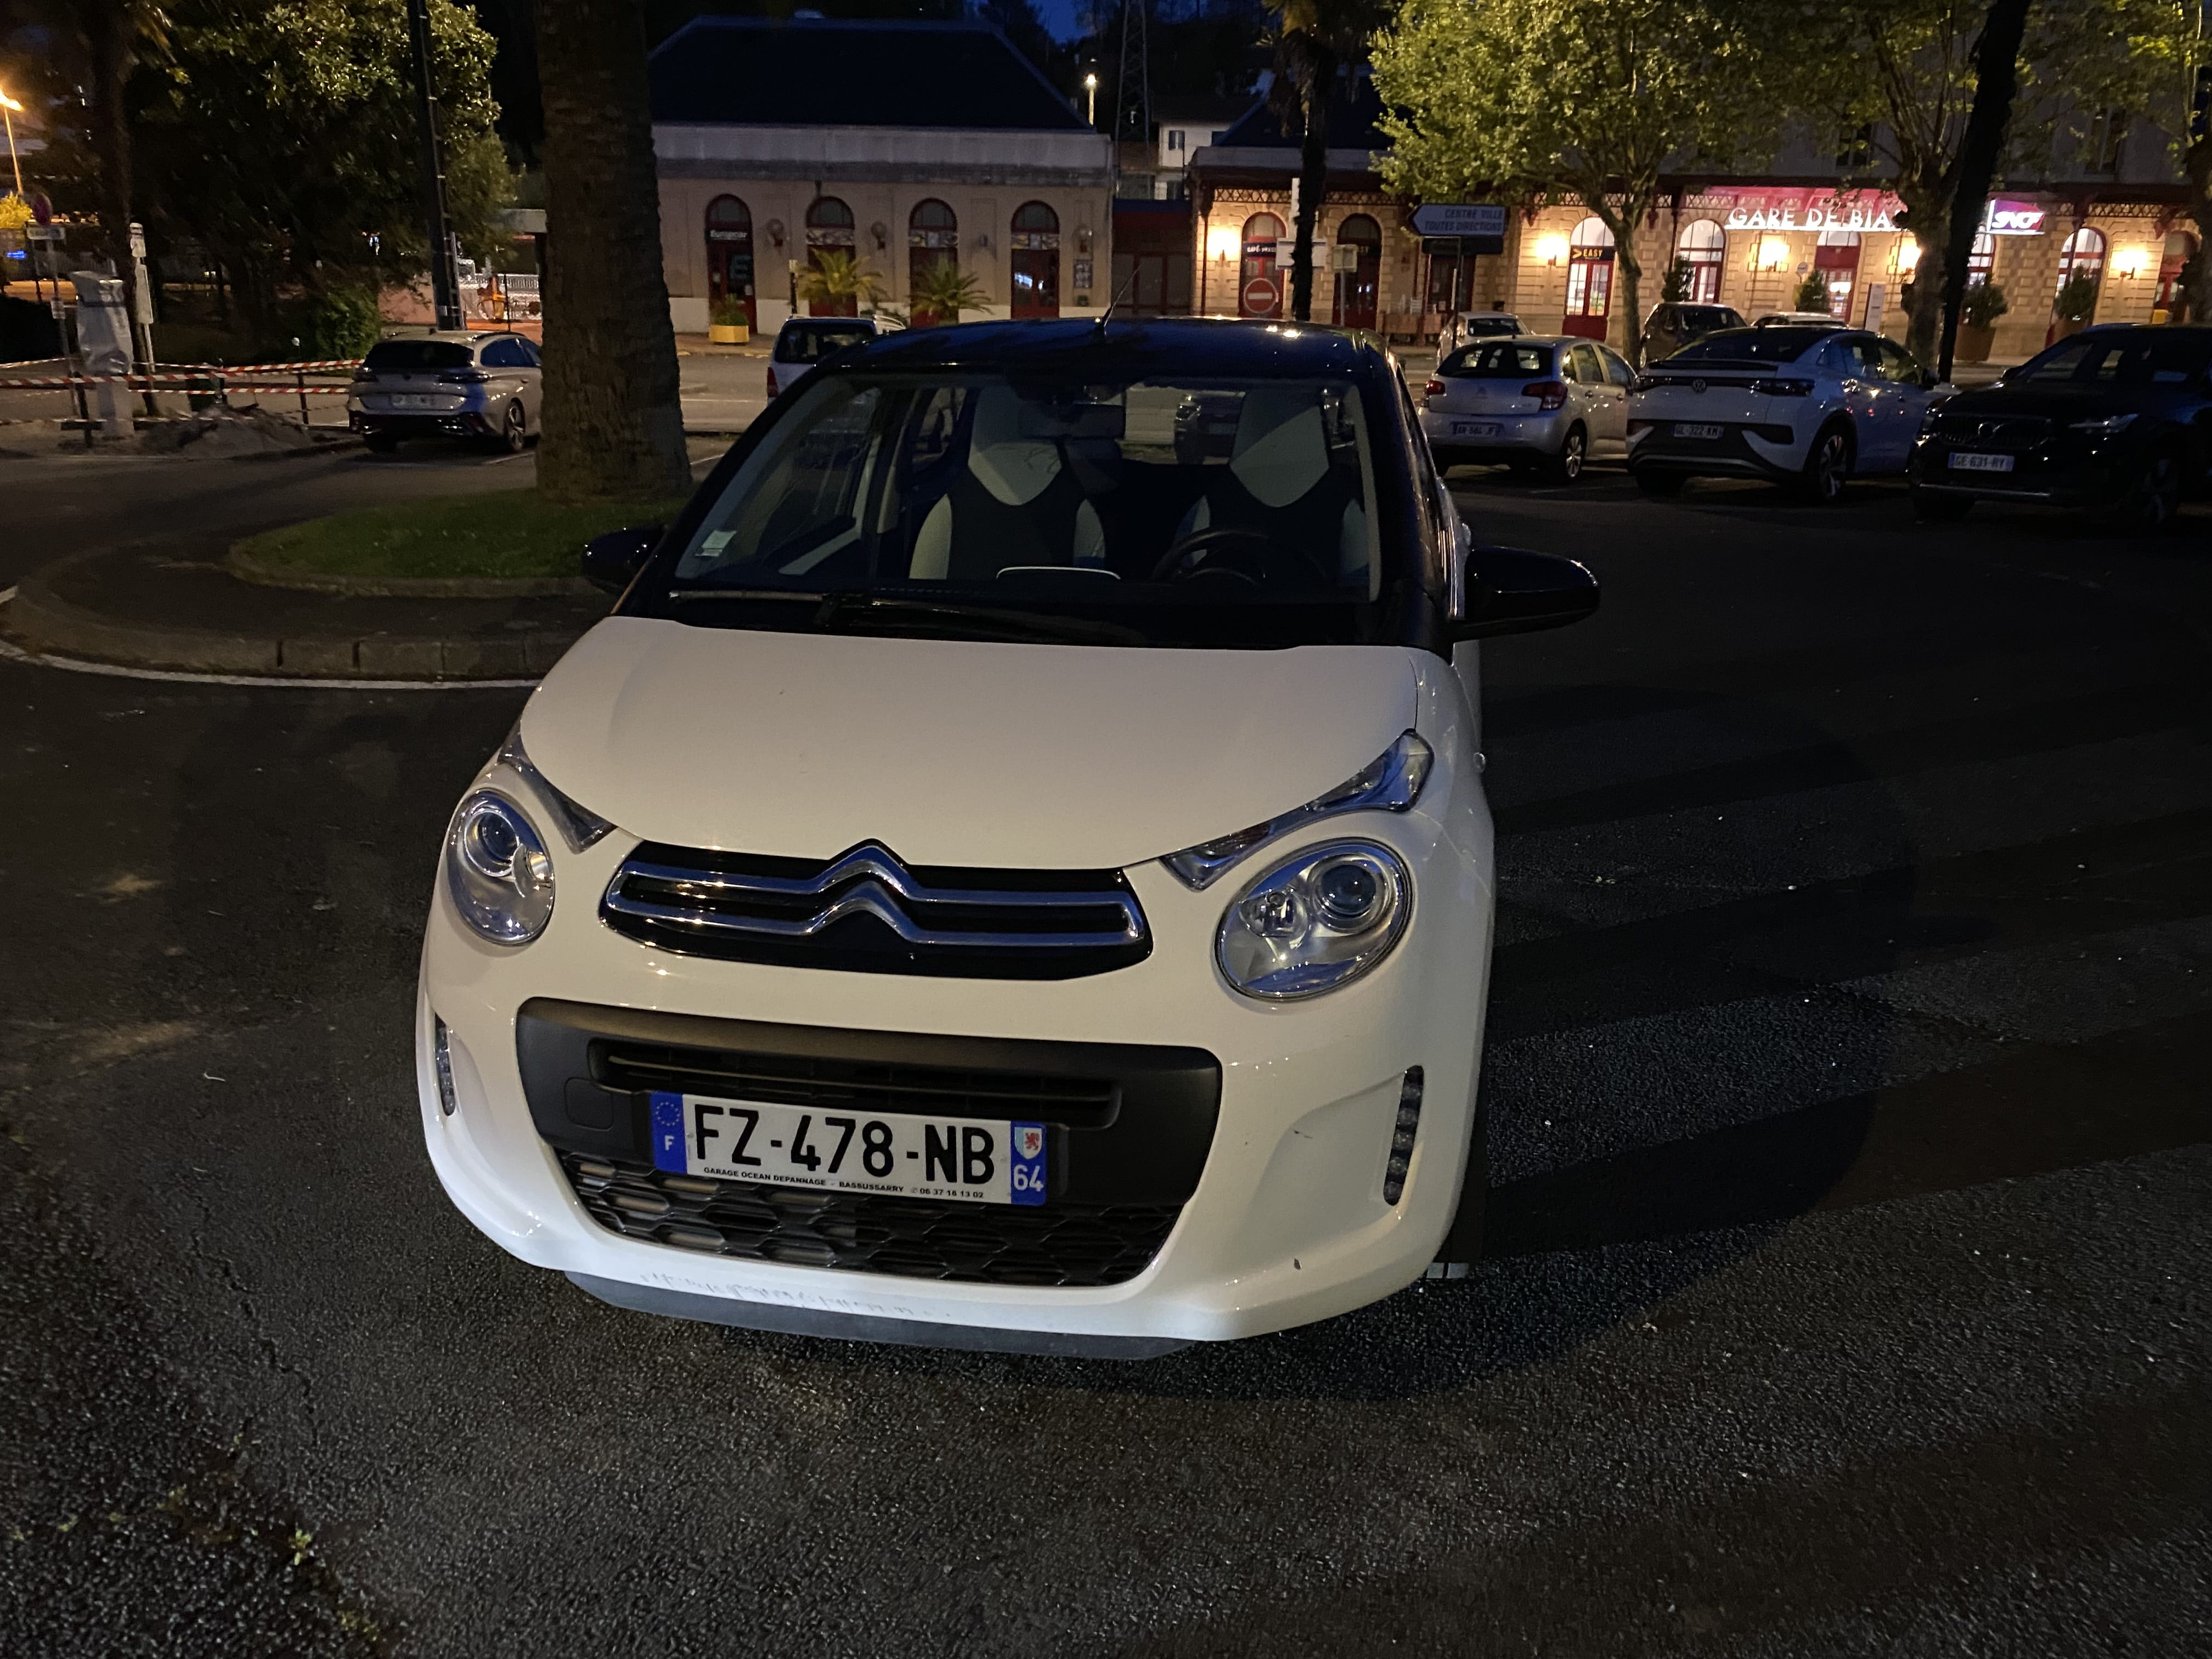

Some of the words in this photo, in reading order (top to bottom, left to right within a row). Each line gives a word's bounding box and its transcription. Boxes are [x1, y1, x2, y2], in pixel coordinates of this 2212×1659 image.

[1729, 207, 1795, 227] GARE
[1805, 208, 1837, 227] DE
[1992, 211, 2045, 229] SNCF
[664, 1136, 674, 1150] F
[694, 1103, 995, 1185] FZ-478-NB
[704, 1167, 738, 1177] GARAGE
[741, 1172, 770, 1181] OCEAN
[774, 1175, 826, 1186] DEPANNAGE
[1013, 1164, 1044, 1192] 64
